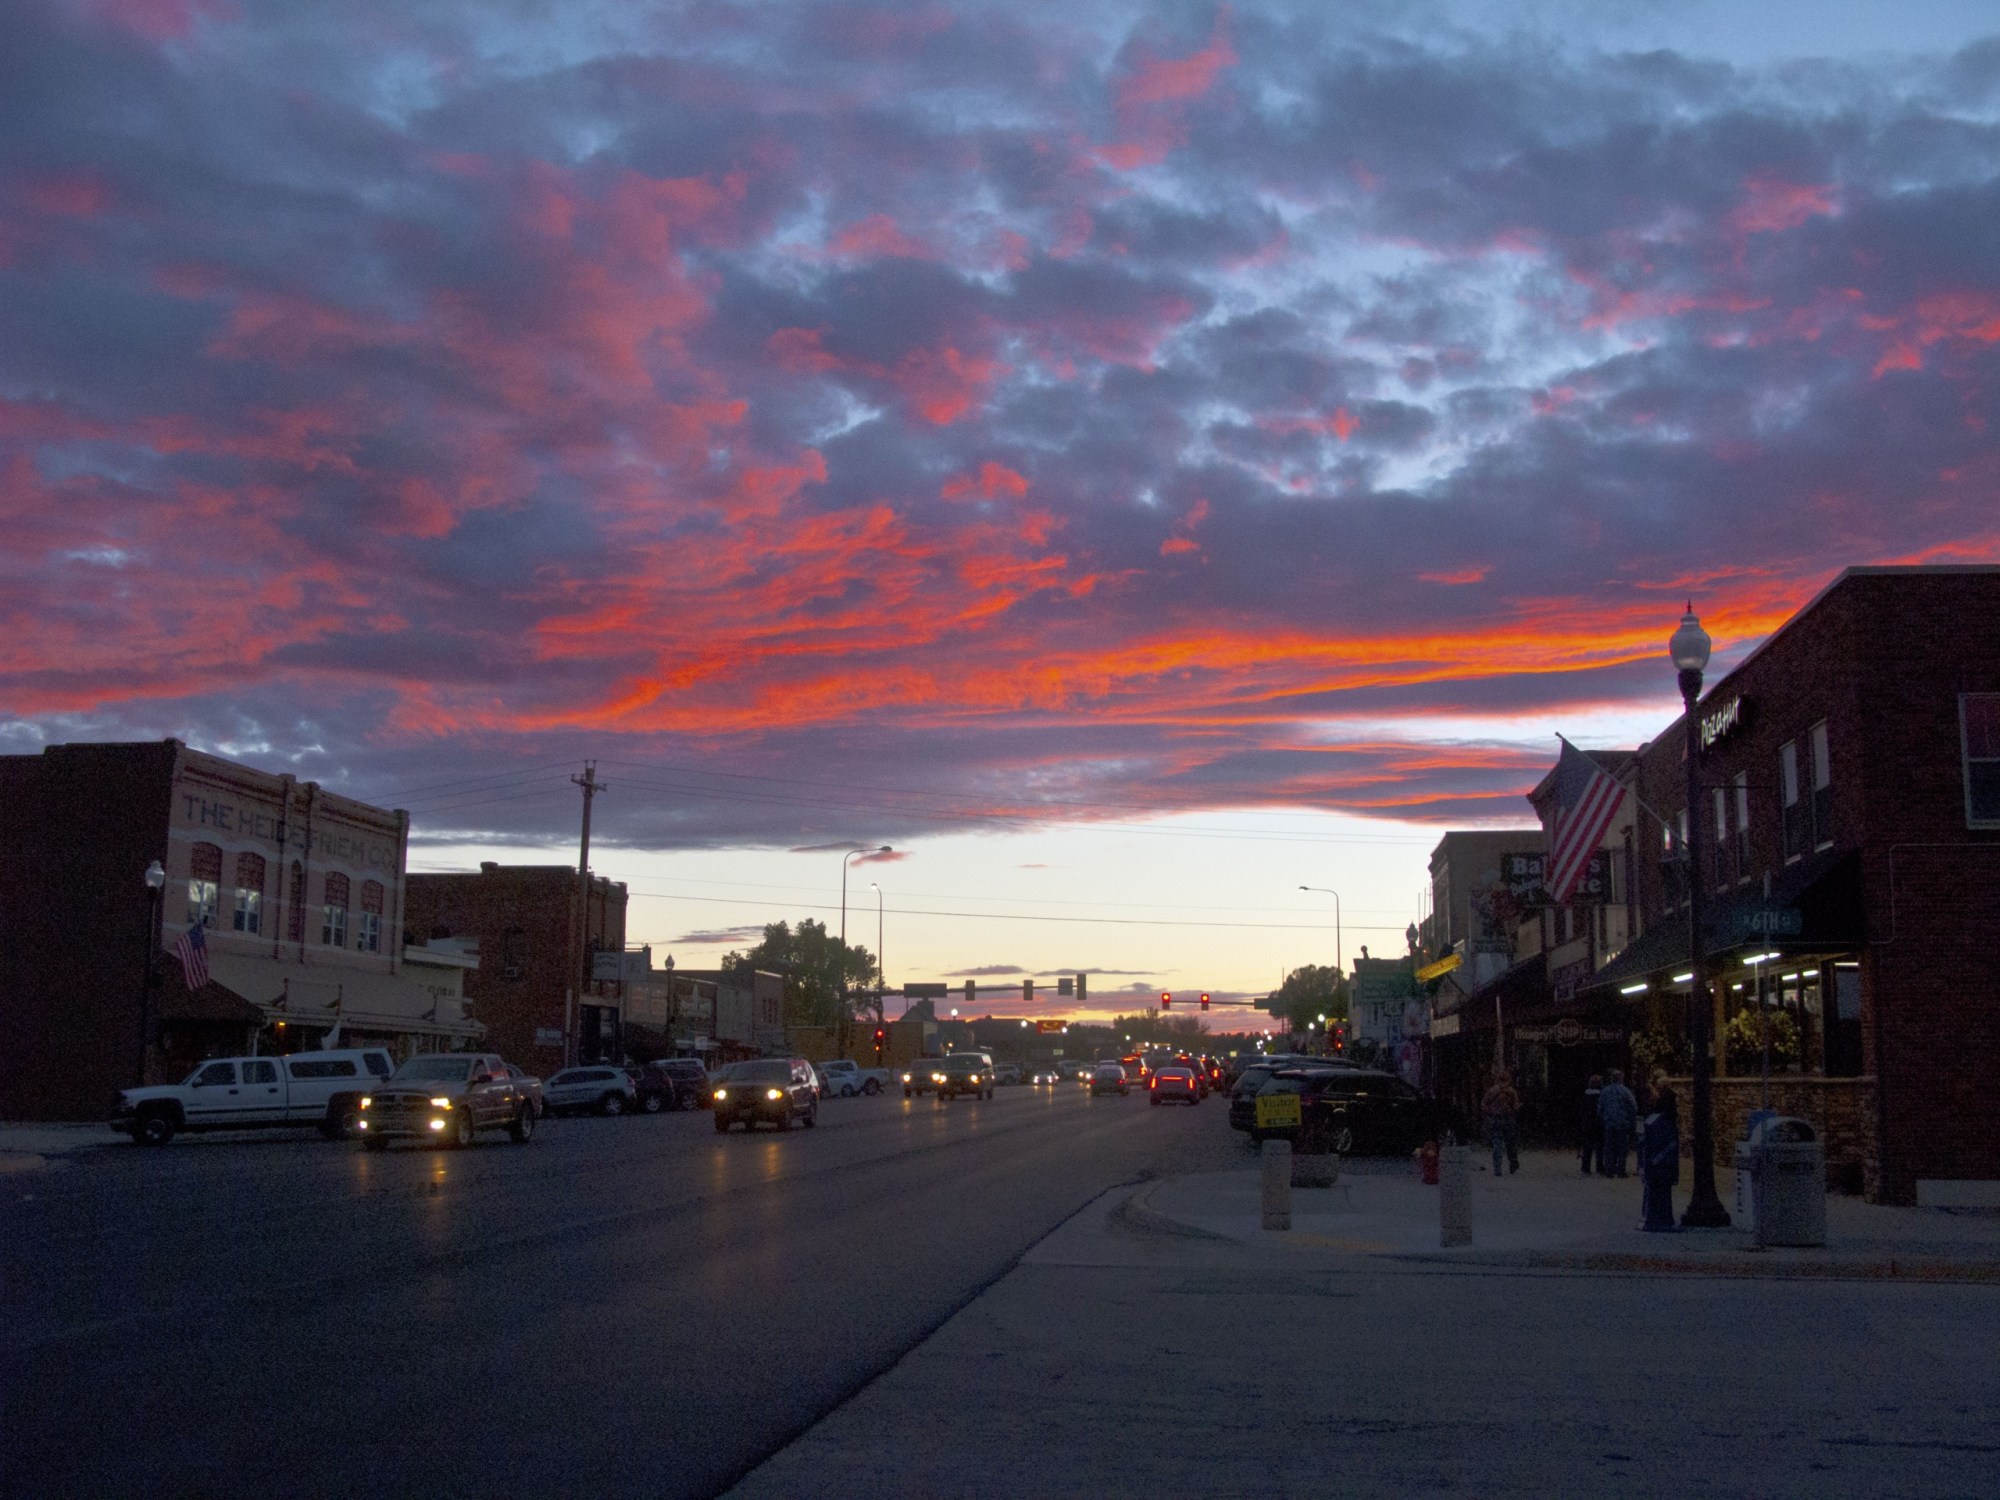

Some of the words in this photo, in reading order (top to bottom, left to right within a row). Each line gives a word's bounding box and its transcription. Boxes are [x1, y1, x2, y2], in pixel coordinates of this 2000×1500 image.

[183, 794, 234, 831] THE
[1752, 911, 1779, 930] 6TH
[1261, 1097, 1296, 1108] Visitor
